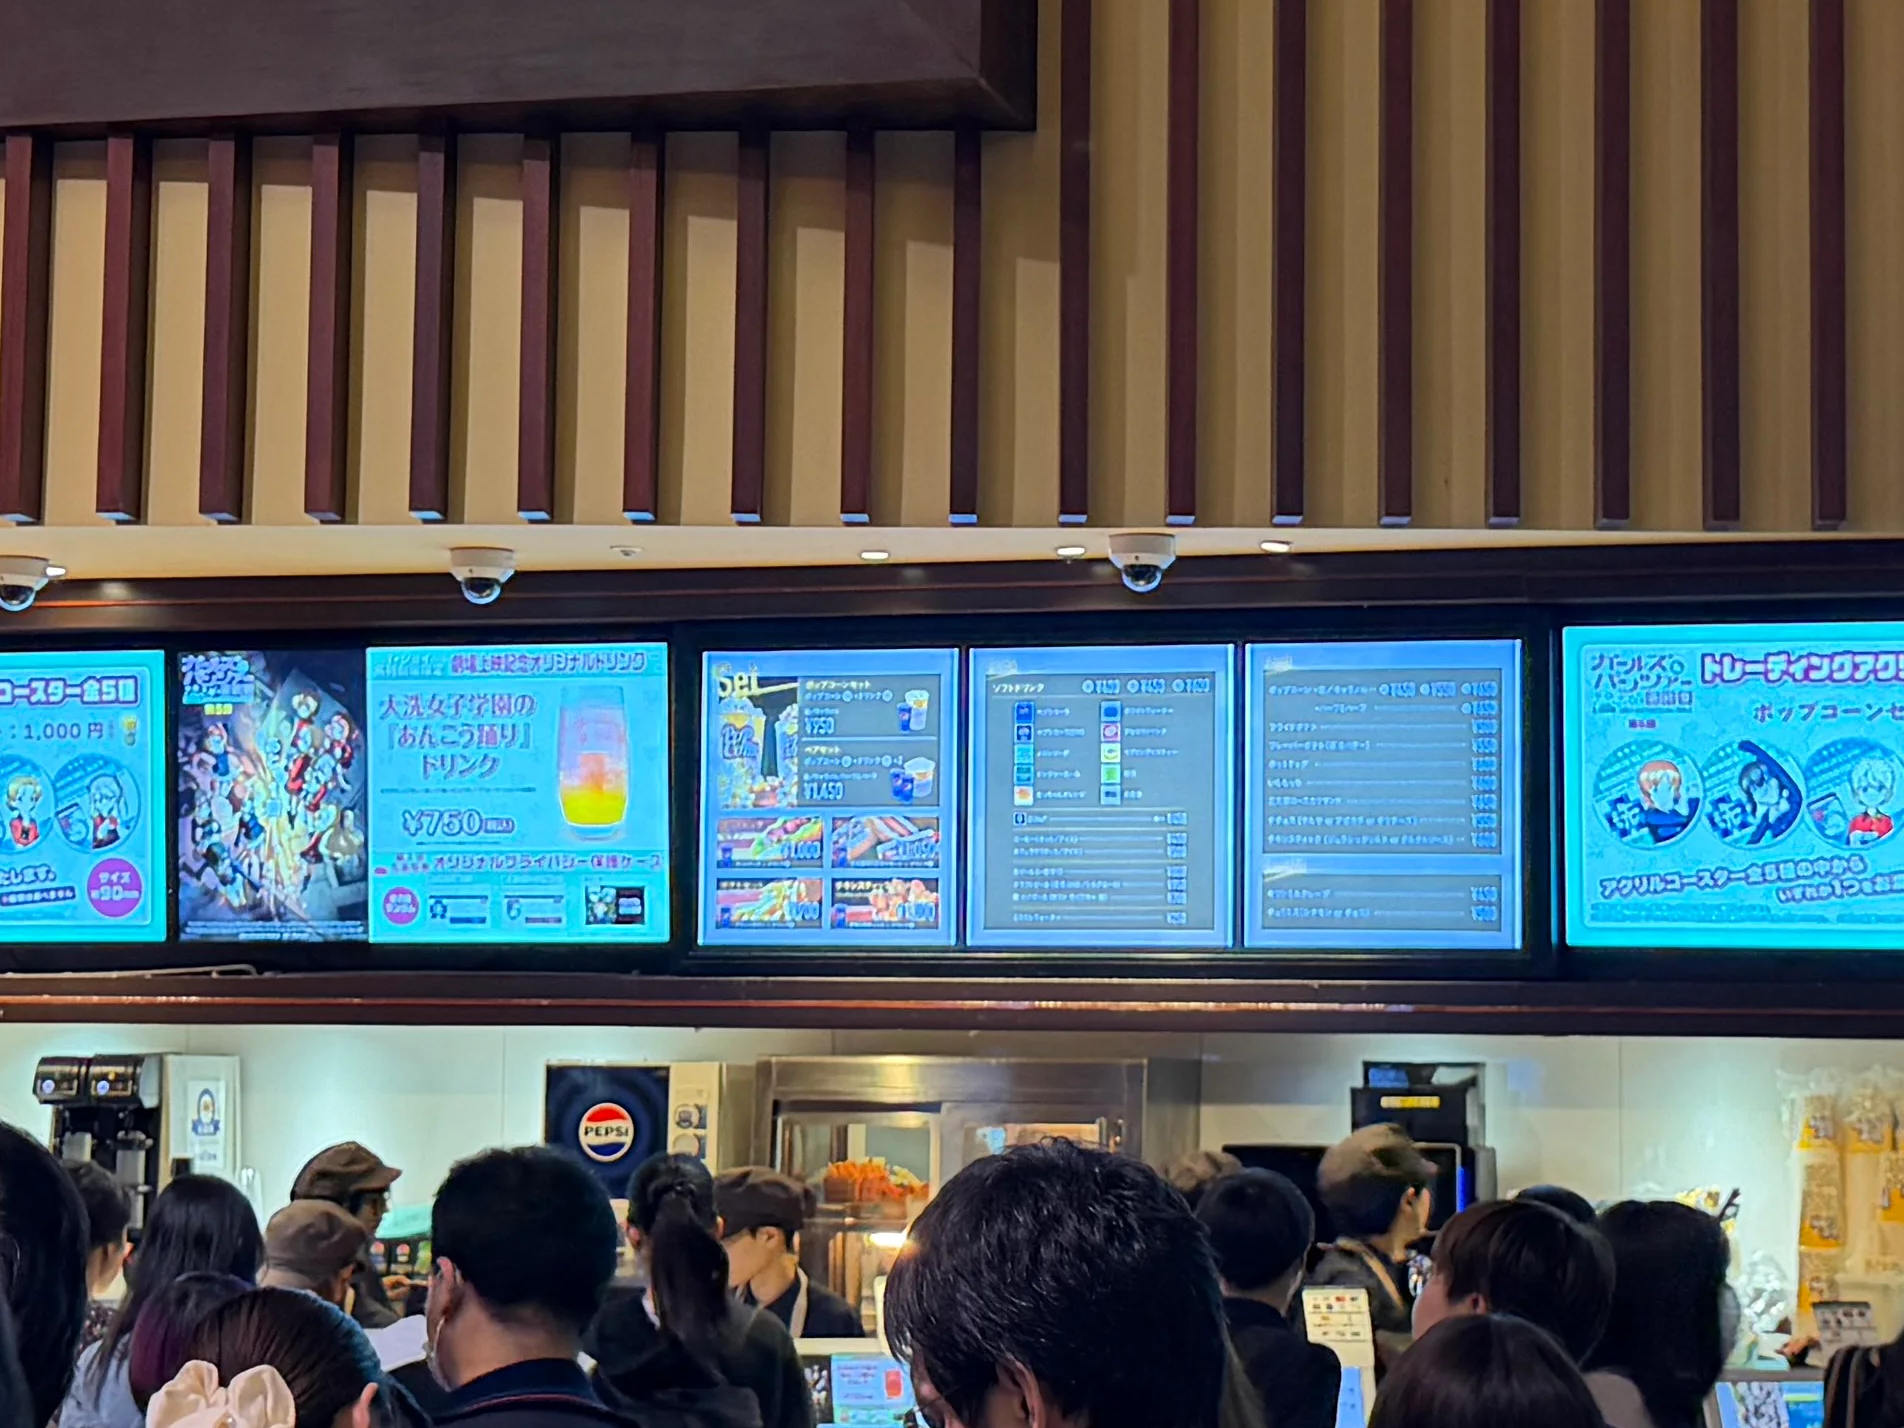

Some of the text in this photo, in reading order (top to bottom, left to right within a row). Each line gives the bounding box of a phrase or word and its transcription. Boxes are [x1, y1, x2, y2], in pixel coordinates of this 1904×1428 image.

[379, 693, 536, 720] 大洗女子学園の
[422, 753, 501, 780] ドリンク
[402, 809, 482, 837] ¥750
[584, 1125, 629, 1137] PEPSI
